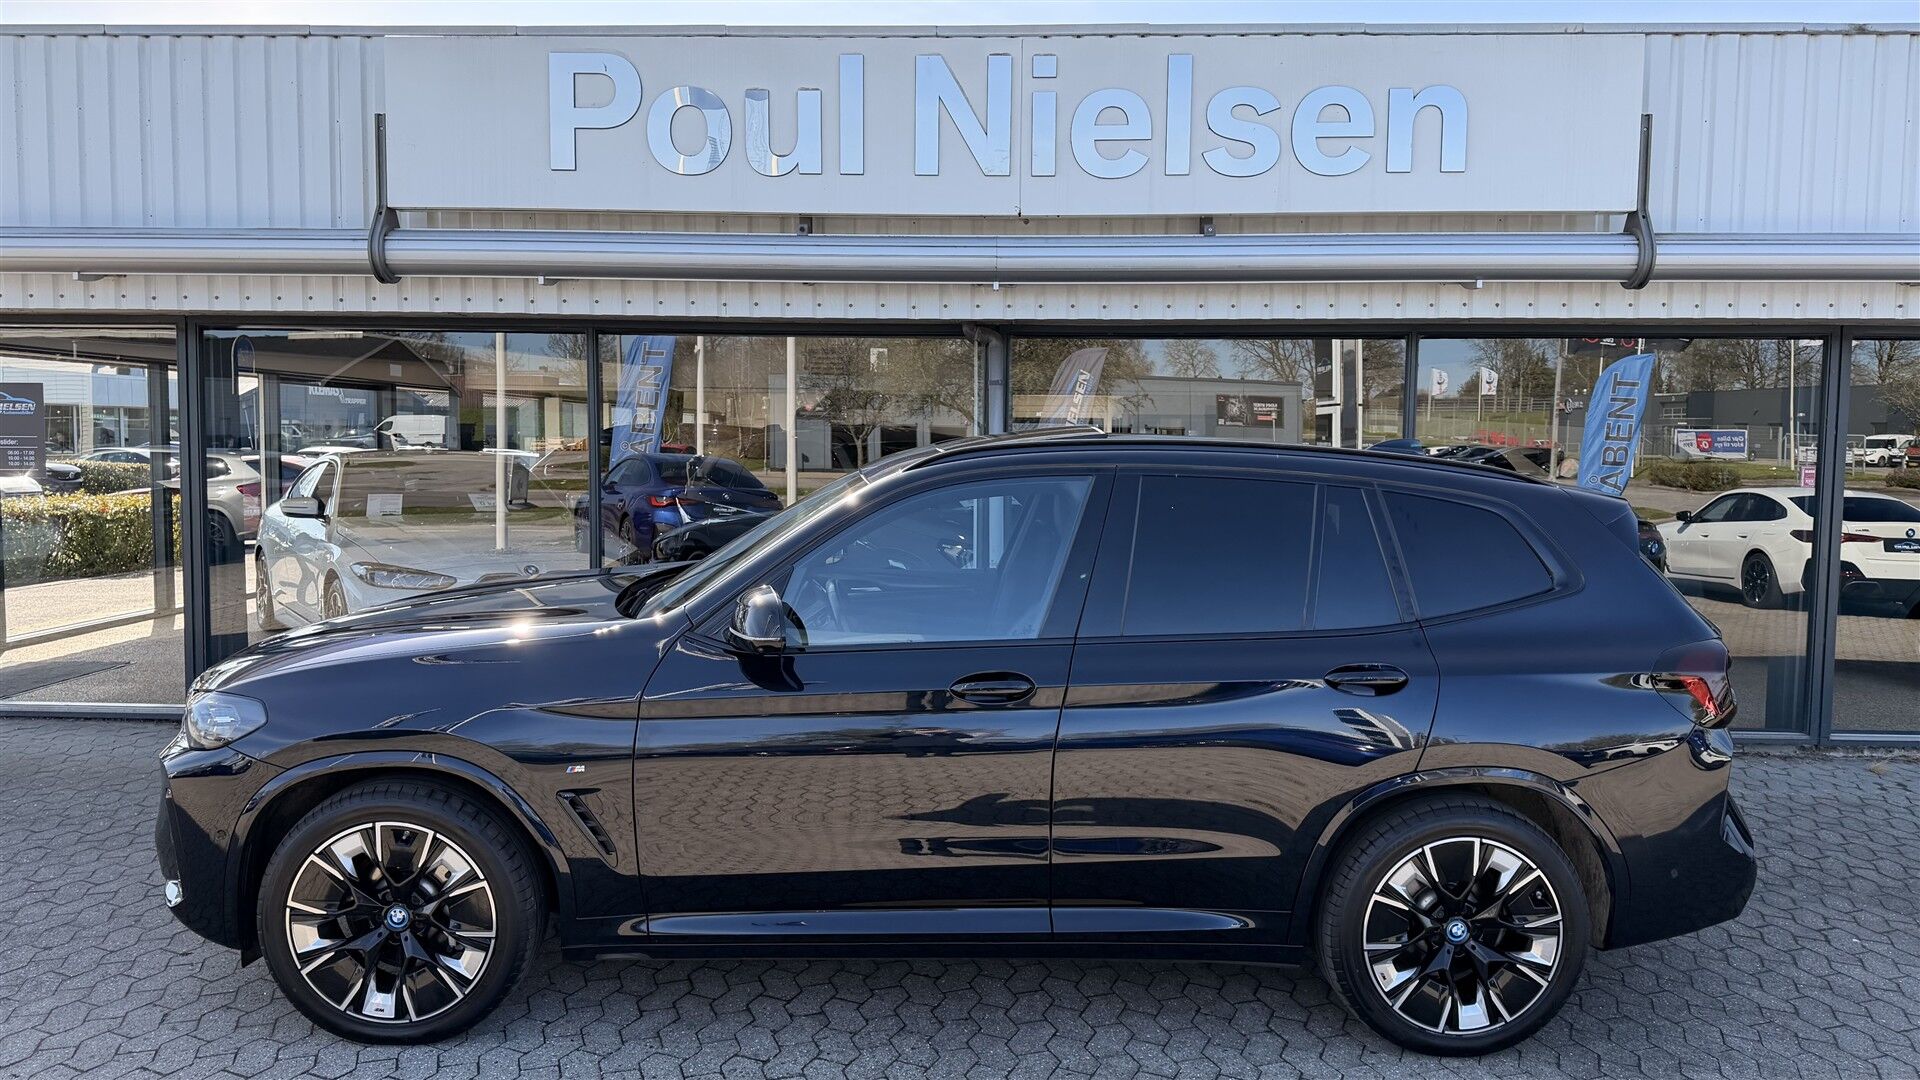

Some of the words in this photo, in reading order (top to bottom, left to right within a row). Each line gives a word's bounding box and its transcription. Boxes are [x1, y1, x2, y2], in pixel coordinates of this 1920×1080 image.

[549, 51, 864, 177] Poul
[914, 53, 1468, 178] Nielsen
[620, 341, 666, 454] ÅBENT
[1588, 371, 1640, 493] ÅBENT
